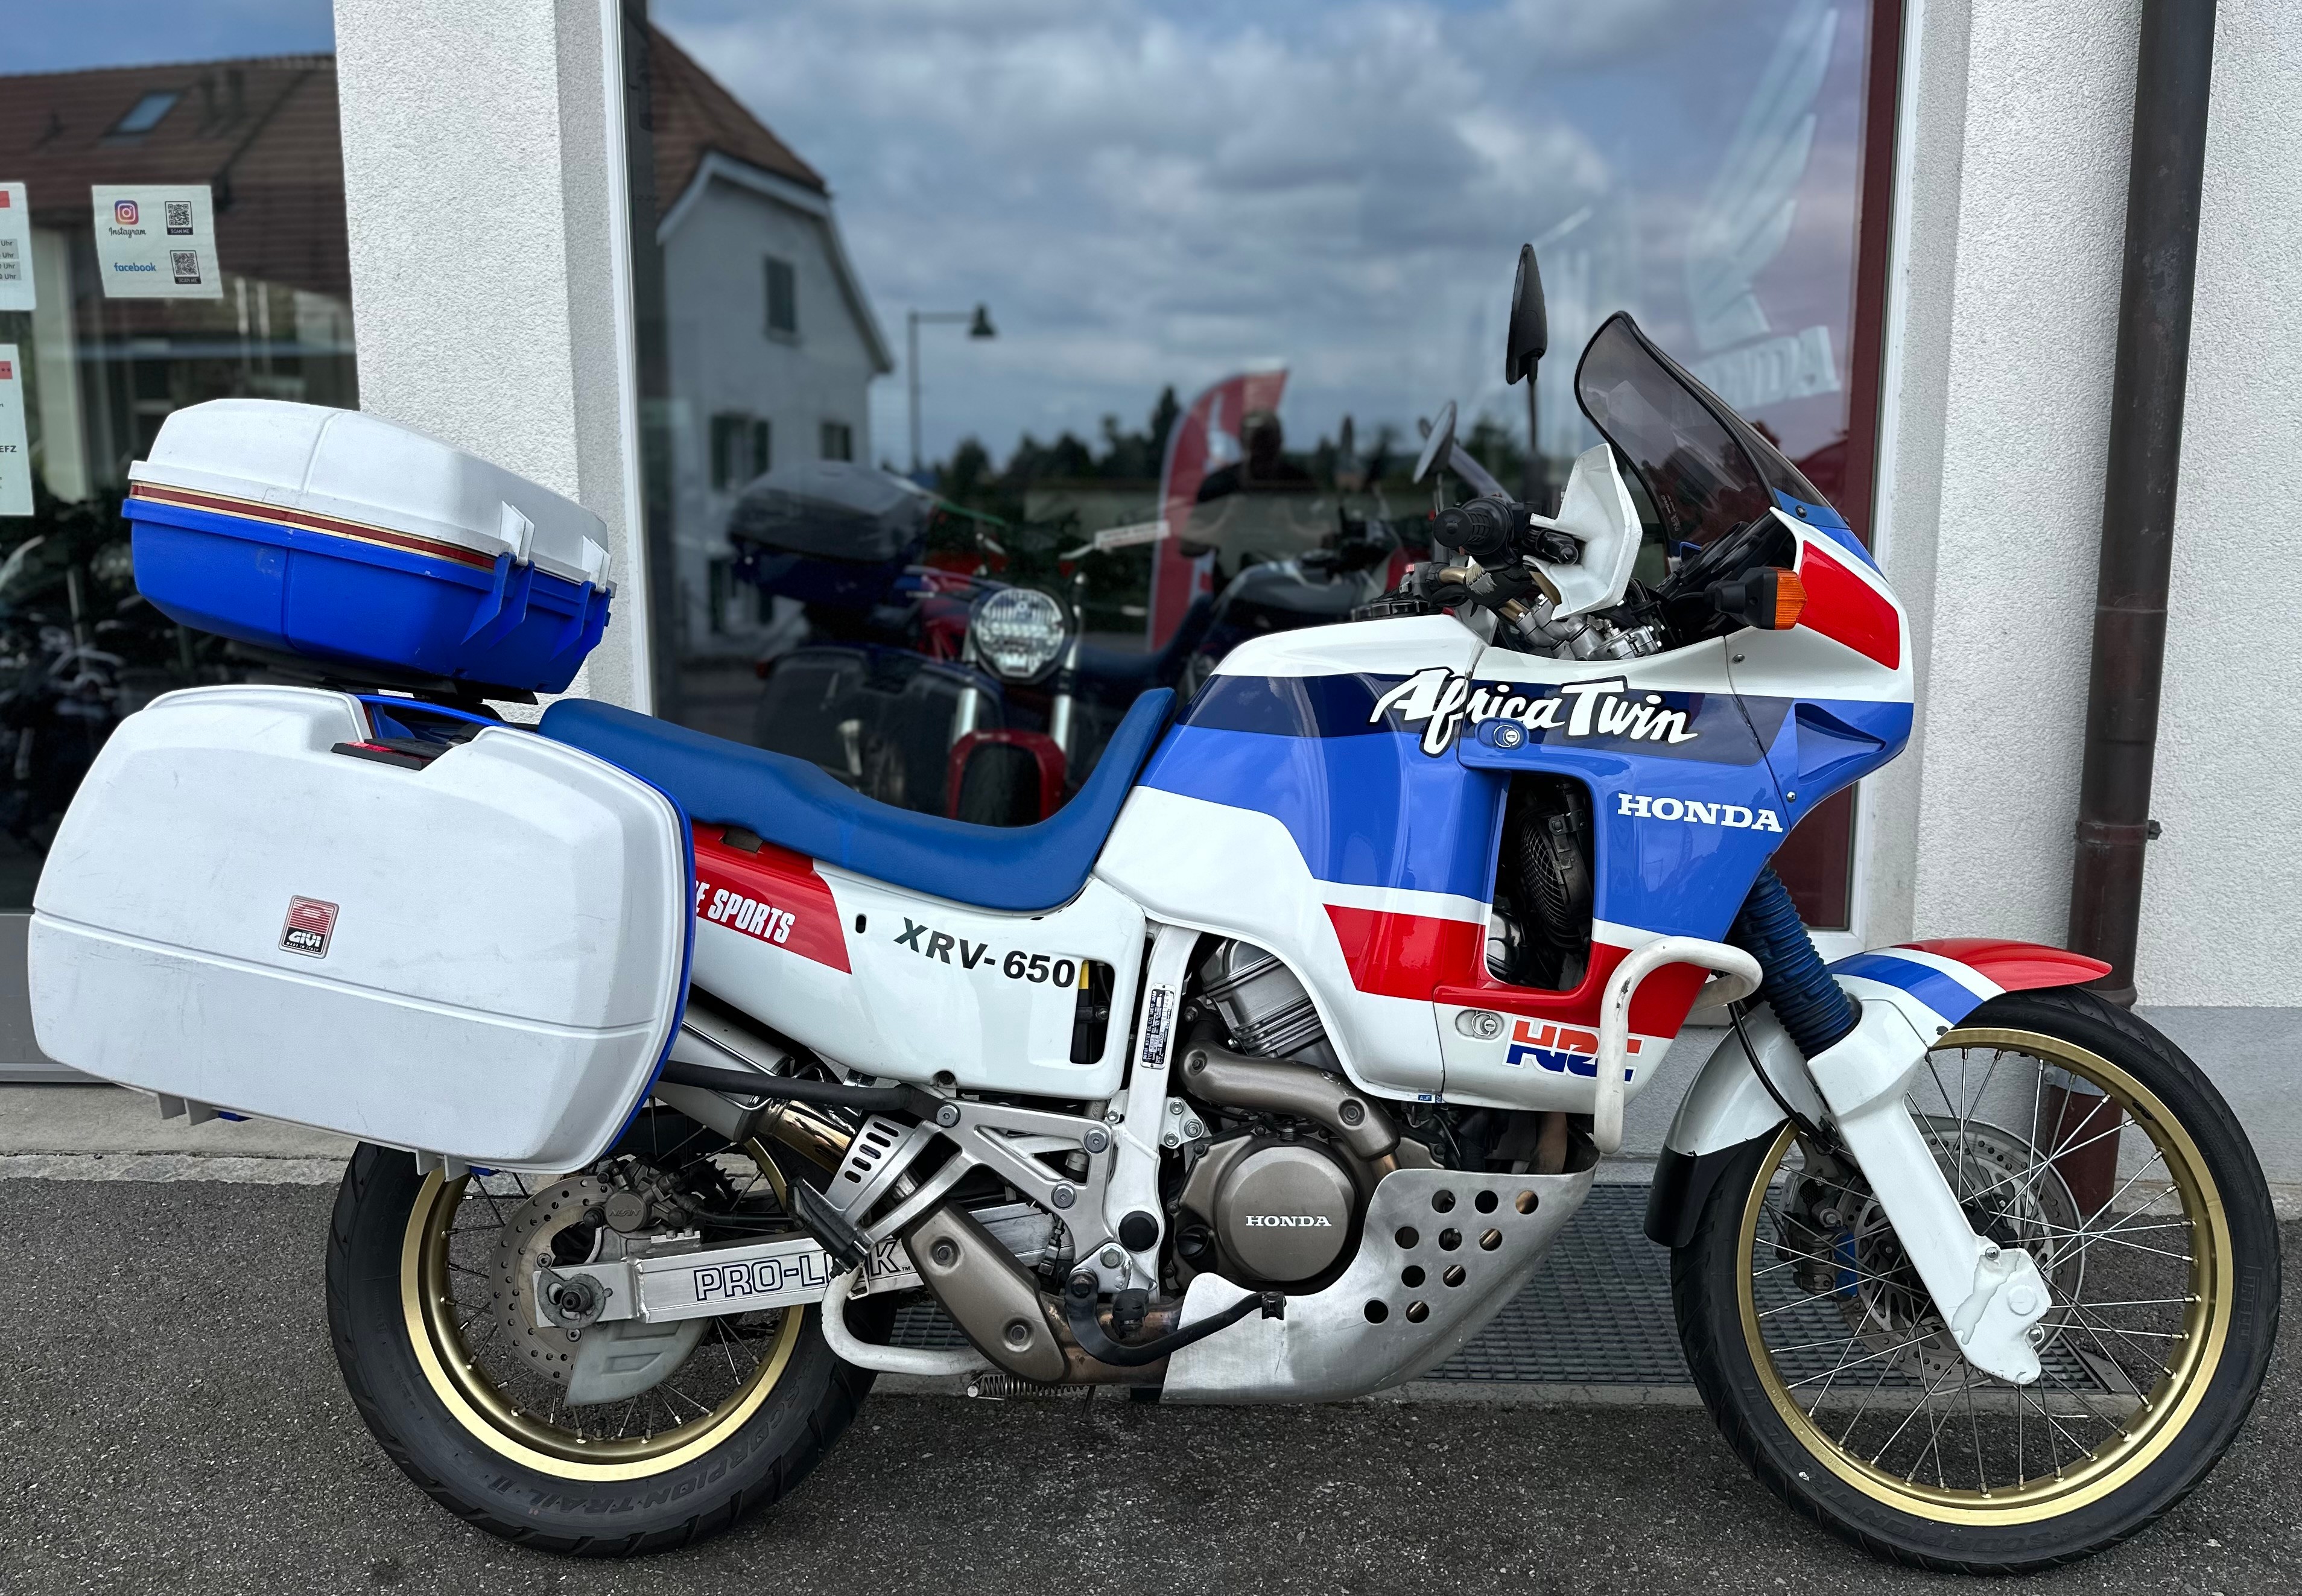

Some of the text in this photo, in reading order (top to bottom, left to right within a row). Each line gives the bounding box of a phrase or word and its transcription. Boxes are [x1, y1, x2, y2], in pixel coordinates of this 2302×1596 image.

[109, 227, 147, 238] Instagram
[113, 262, 157, 272] facebook
[1369, 668, 1699, 755] Africa Twin
[1617, 793, 1783, 833] HONDA
[707, 888, 796, 944] SPORTS
[1245, 1215, 1332, 1227] HONDA
[643, 1376, 801, 1510] SCORPION
[528, 1487, 635, 1515] TRAIL
[1857, 1510, 2053, 1553] SCORPION
